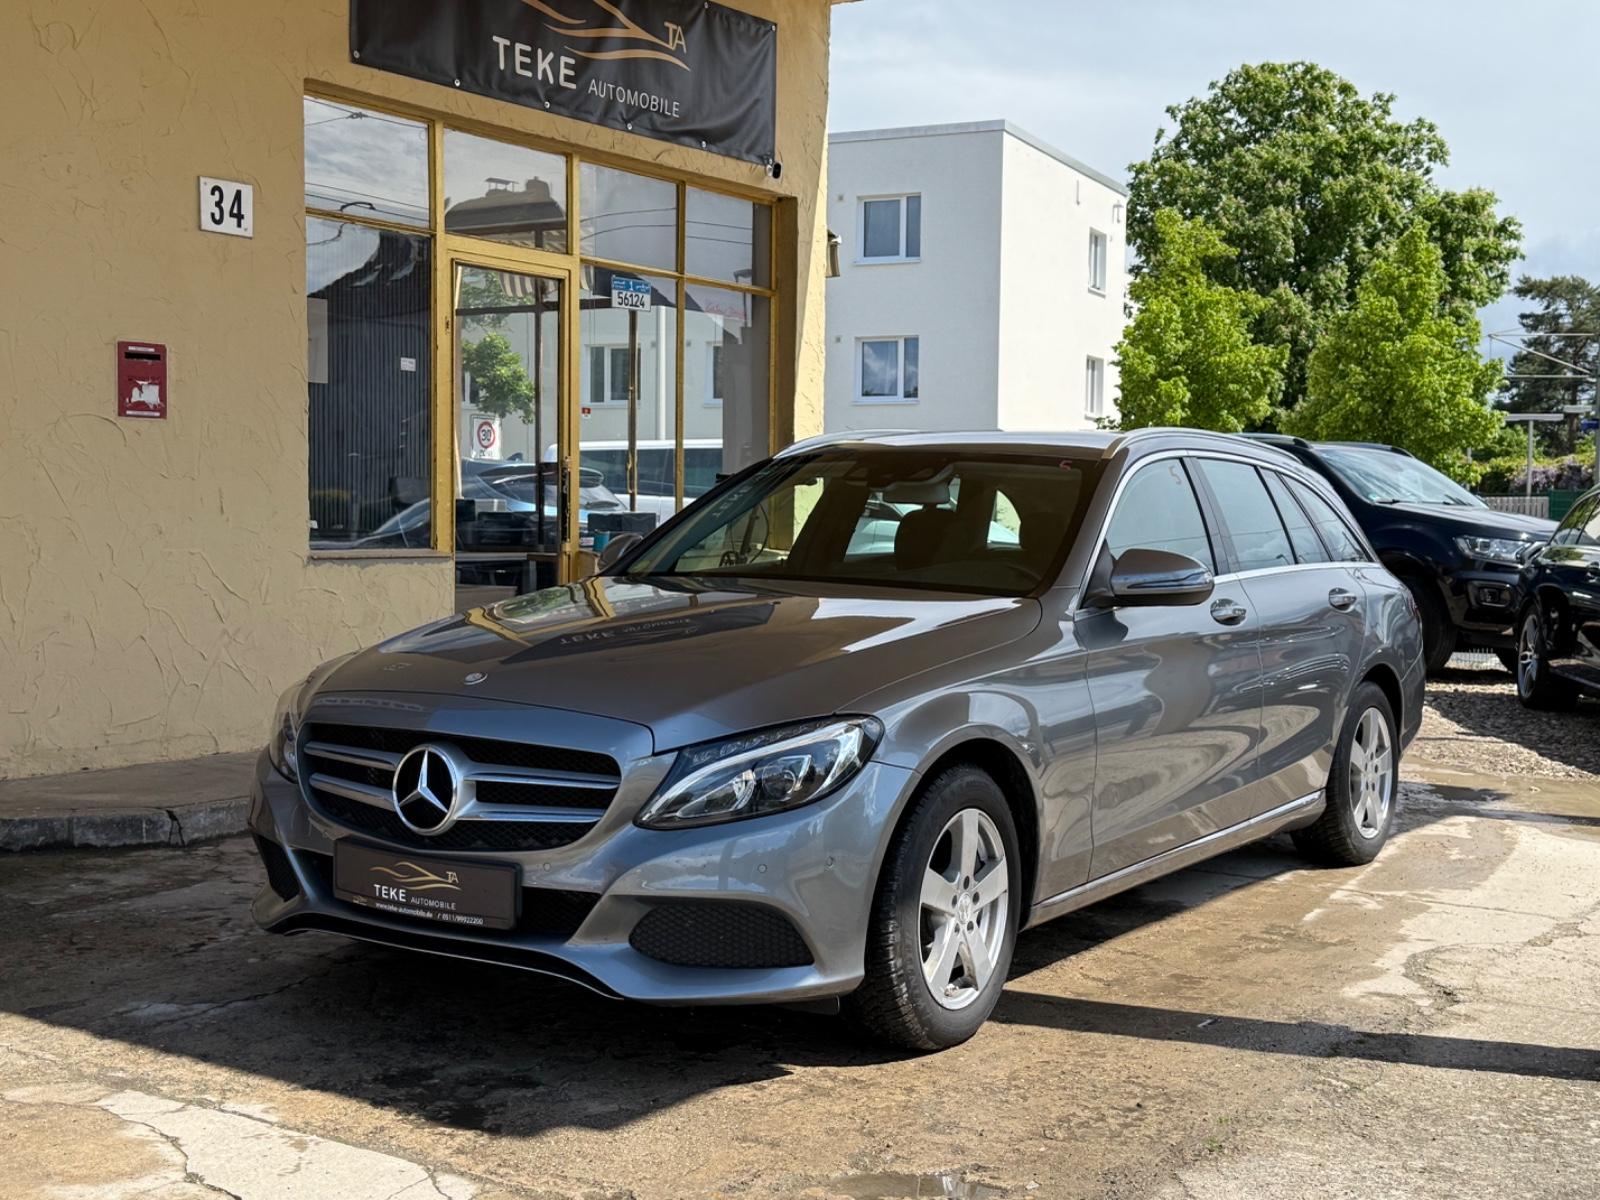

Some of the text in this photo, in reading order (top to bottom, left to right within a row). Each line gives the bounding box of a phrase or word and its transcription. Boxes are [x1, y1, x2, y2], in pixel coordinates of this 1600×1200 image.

[664, 21, 687, 53] TA
[492, 35, 680, 118] TEKE AUTOMOBILE
[210, 185, 245, 229] 34
[617, 291, 646, 308] 56124
[481, 428, 492, 441] 30
[446, 871, 459, 883] TA
[373, 884, 457, 910] TEKE AUTOMOBILE
